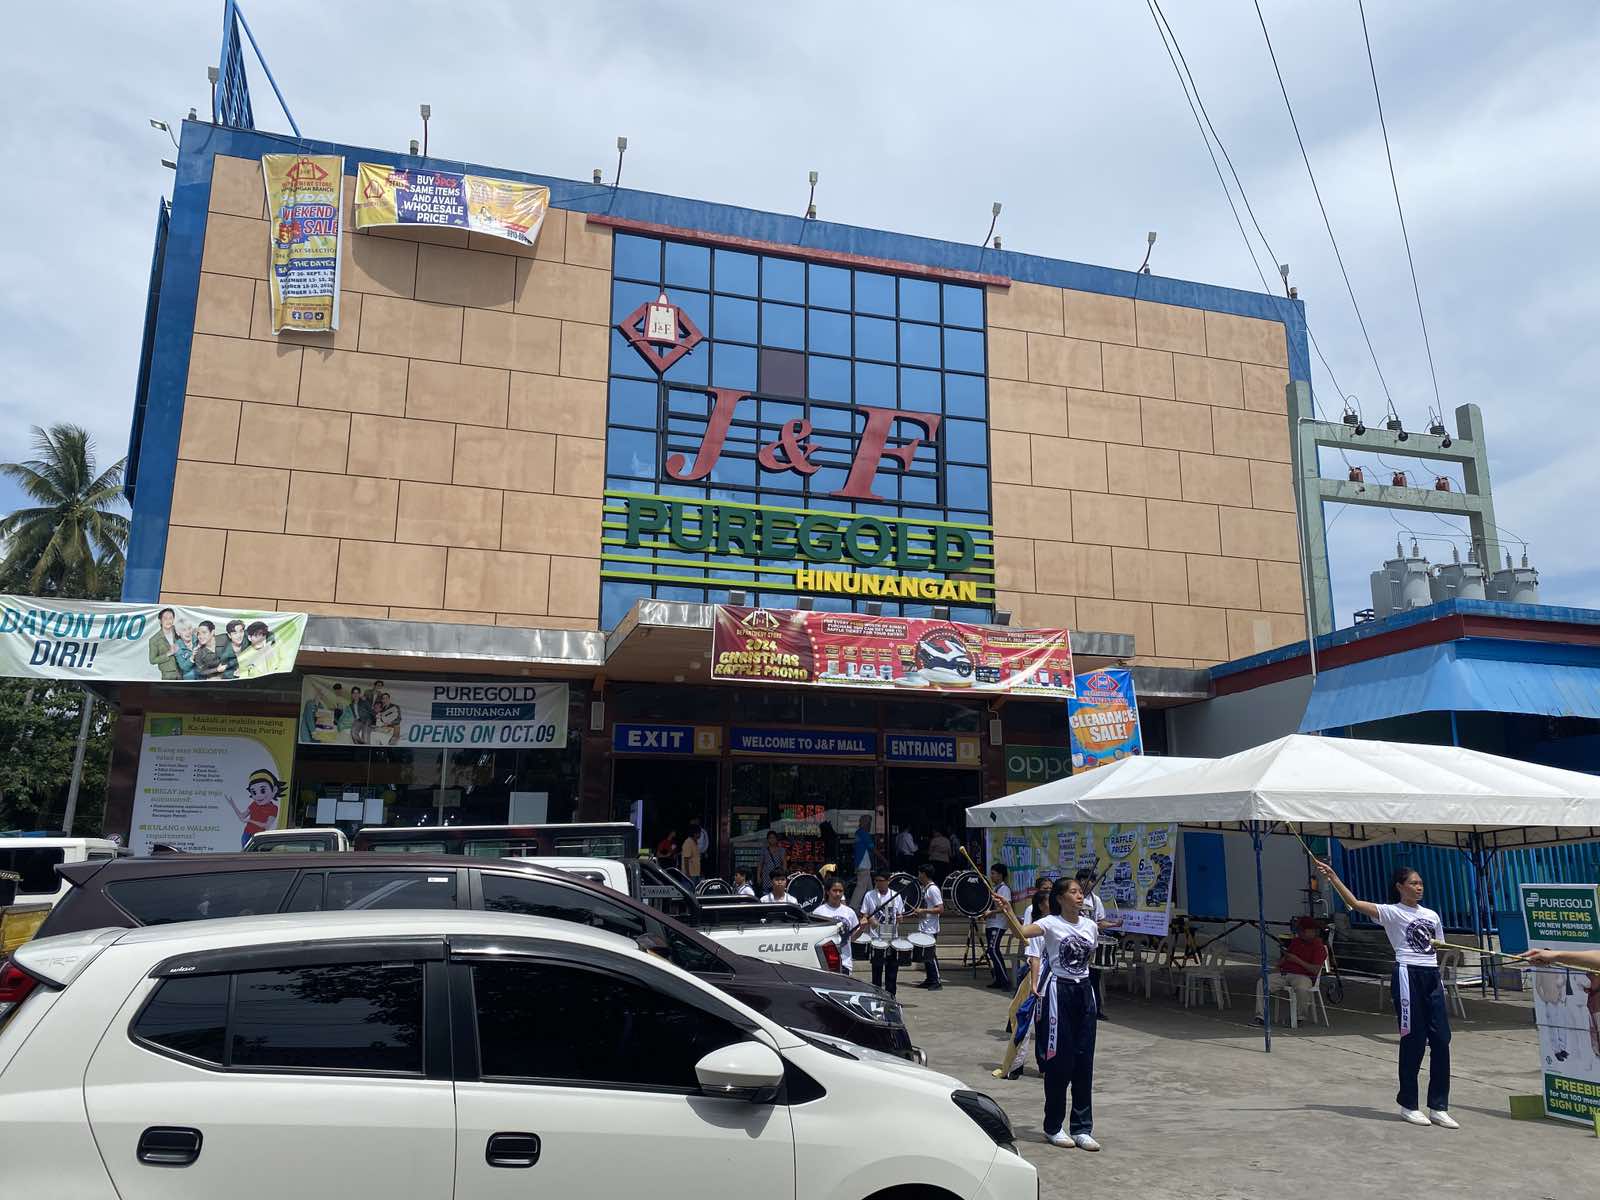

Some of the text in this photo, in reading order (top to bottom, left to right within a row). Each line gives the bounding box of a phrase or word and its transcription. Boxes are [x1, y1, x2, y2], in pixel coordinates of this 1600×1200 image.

[416, 174, 434, 185] BUY
[409, 184, 460, 196] SAME ITEMS
[412, 194, 458, 205] AND AVAIL
[403, 200, 464, 216] WHOLESALE
[416, 212, 449, 224] PRICE!
[626, 497, 976, 571] PUREGOLD
[796, 569, 977, 601] HINUNANGAN
[1, 607, 146, 641] DAYON MO
[745, 639, 778, 651] 2024
[29, 639, 98, 668] DIRI!
[719, 651, 800, 667] CHRISTMAS
[714, 663, 808, 679] RAFFLE PROMO
[433, 686, 537, 701] PUREGOLD
[445, 706, 520, 718] HINUNANGAN
[1070, 707, 1137, 729] CLEARANCE
[408, 724, 556, 744] OPENS ON OCT.09
[628, 730, 684, 748] EXIT
[1089, 722, 1129, 743] SALE!
[742, 735, 866, 752] WELCOME TO J&F MALL
[891, 740, 954, 758] ENTRANCE
[1110, 834, 1133, 844] RAFFLE
[1111, 844, 1132, 854] PRIZES
[1138, 858, 1144, 870] 6
[1540, 898, 1593, 909] PUREGOLD
[1532, 910, 1592, 922] FREE ITEMS
[758, 942, 809, 953] CALIBRE
[1570, 1094, 1582, 1102] 100
[1550, 1098, 1572, 1111] SIGN
[1574, 1103, 1588, 1114] UP
